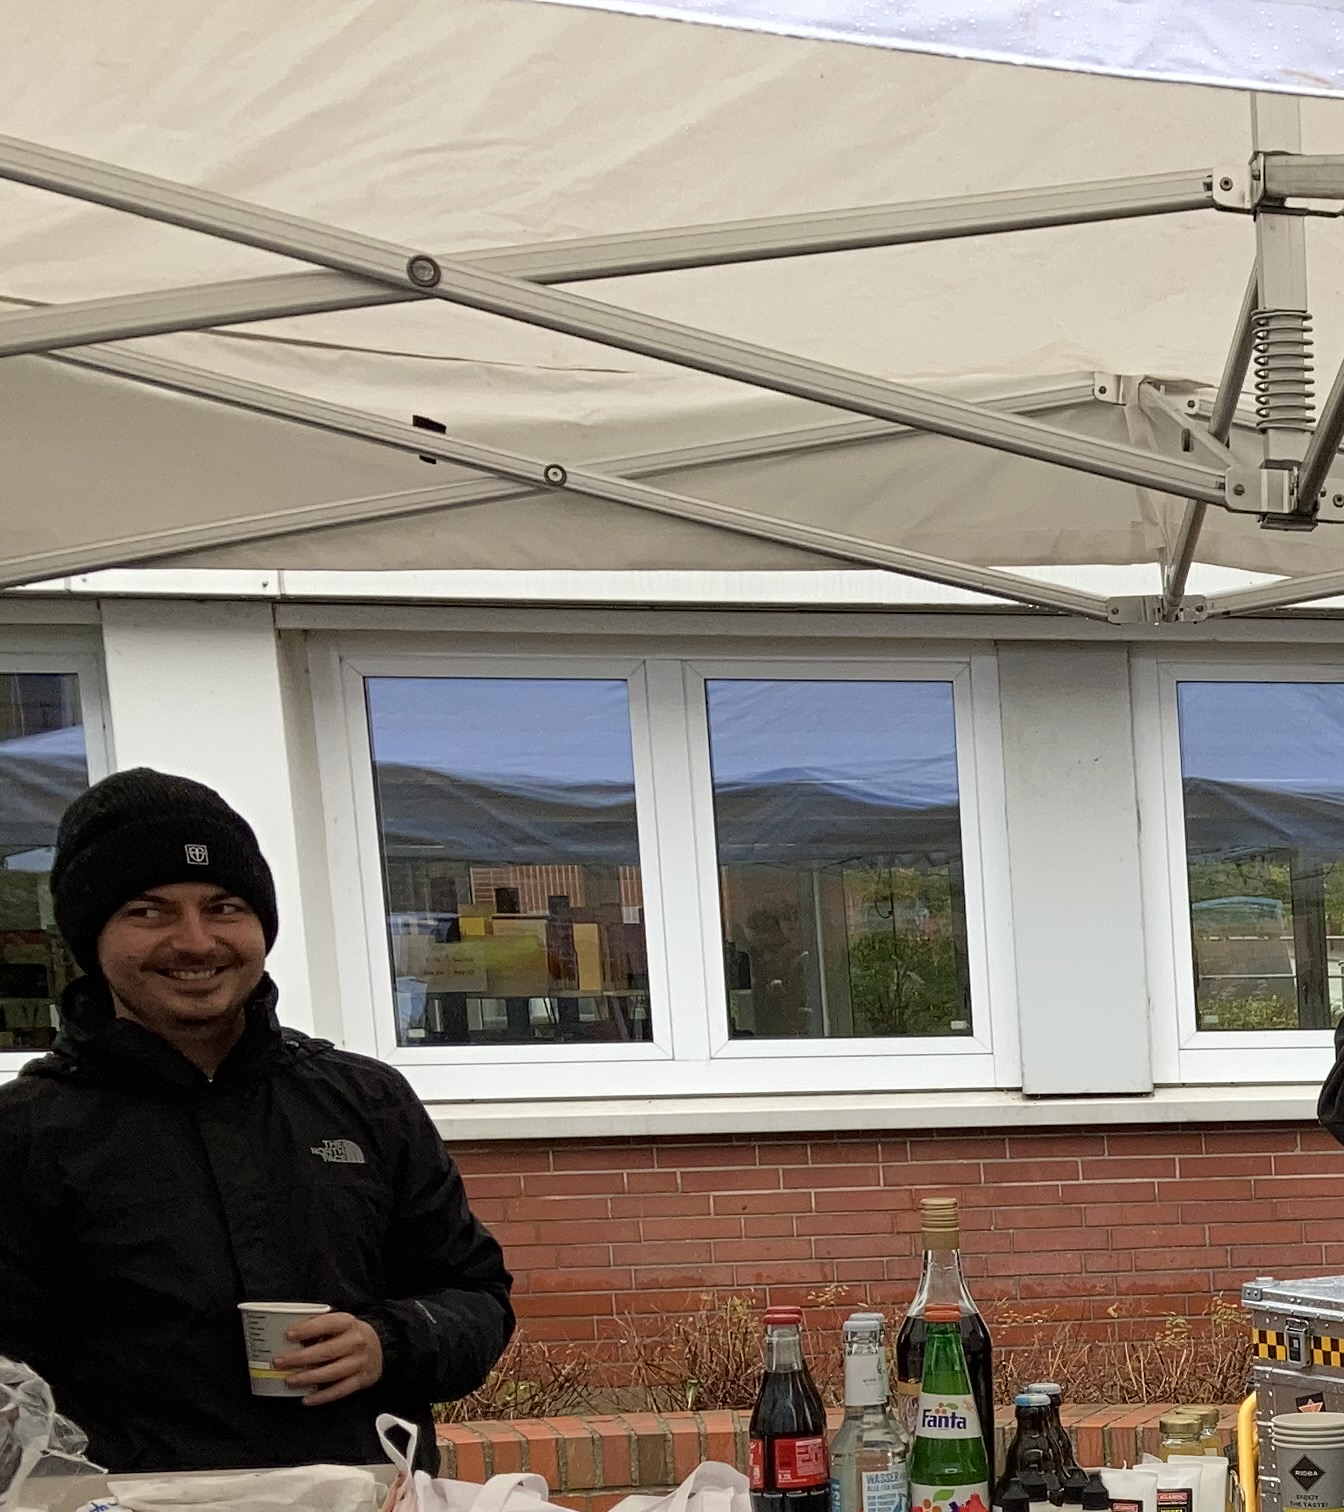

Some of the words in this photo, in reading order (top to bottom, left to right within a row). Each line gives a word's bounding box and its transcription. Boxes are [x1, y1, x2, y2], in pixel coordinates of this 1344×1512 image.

[321, 1139, 345, 1149] THE
[310, 1146, 347, 1156] NORTH
[921, 1408, 967, 1430] Fanta
[1296, 1493, 1319, 1501] ENJOY
